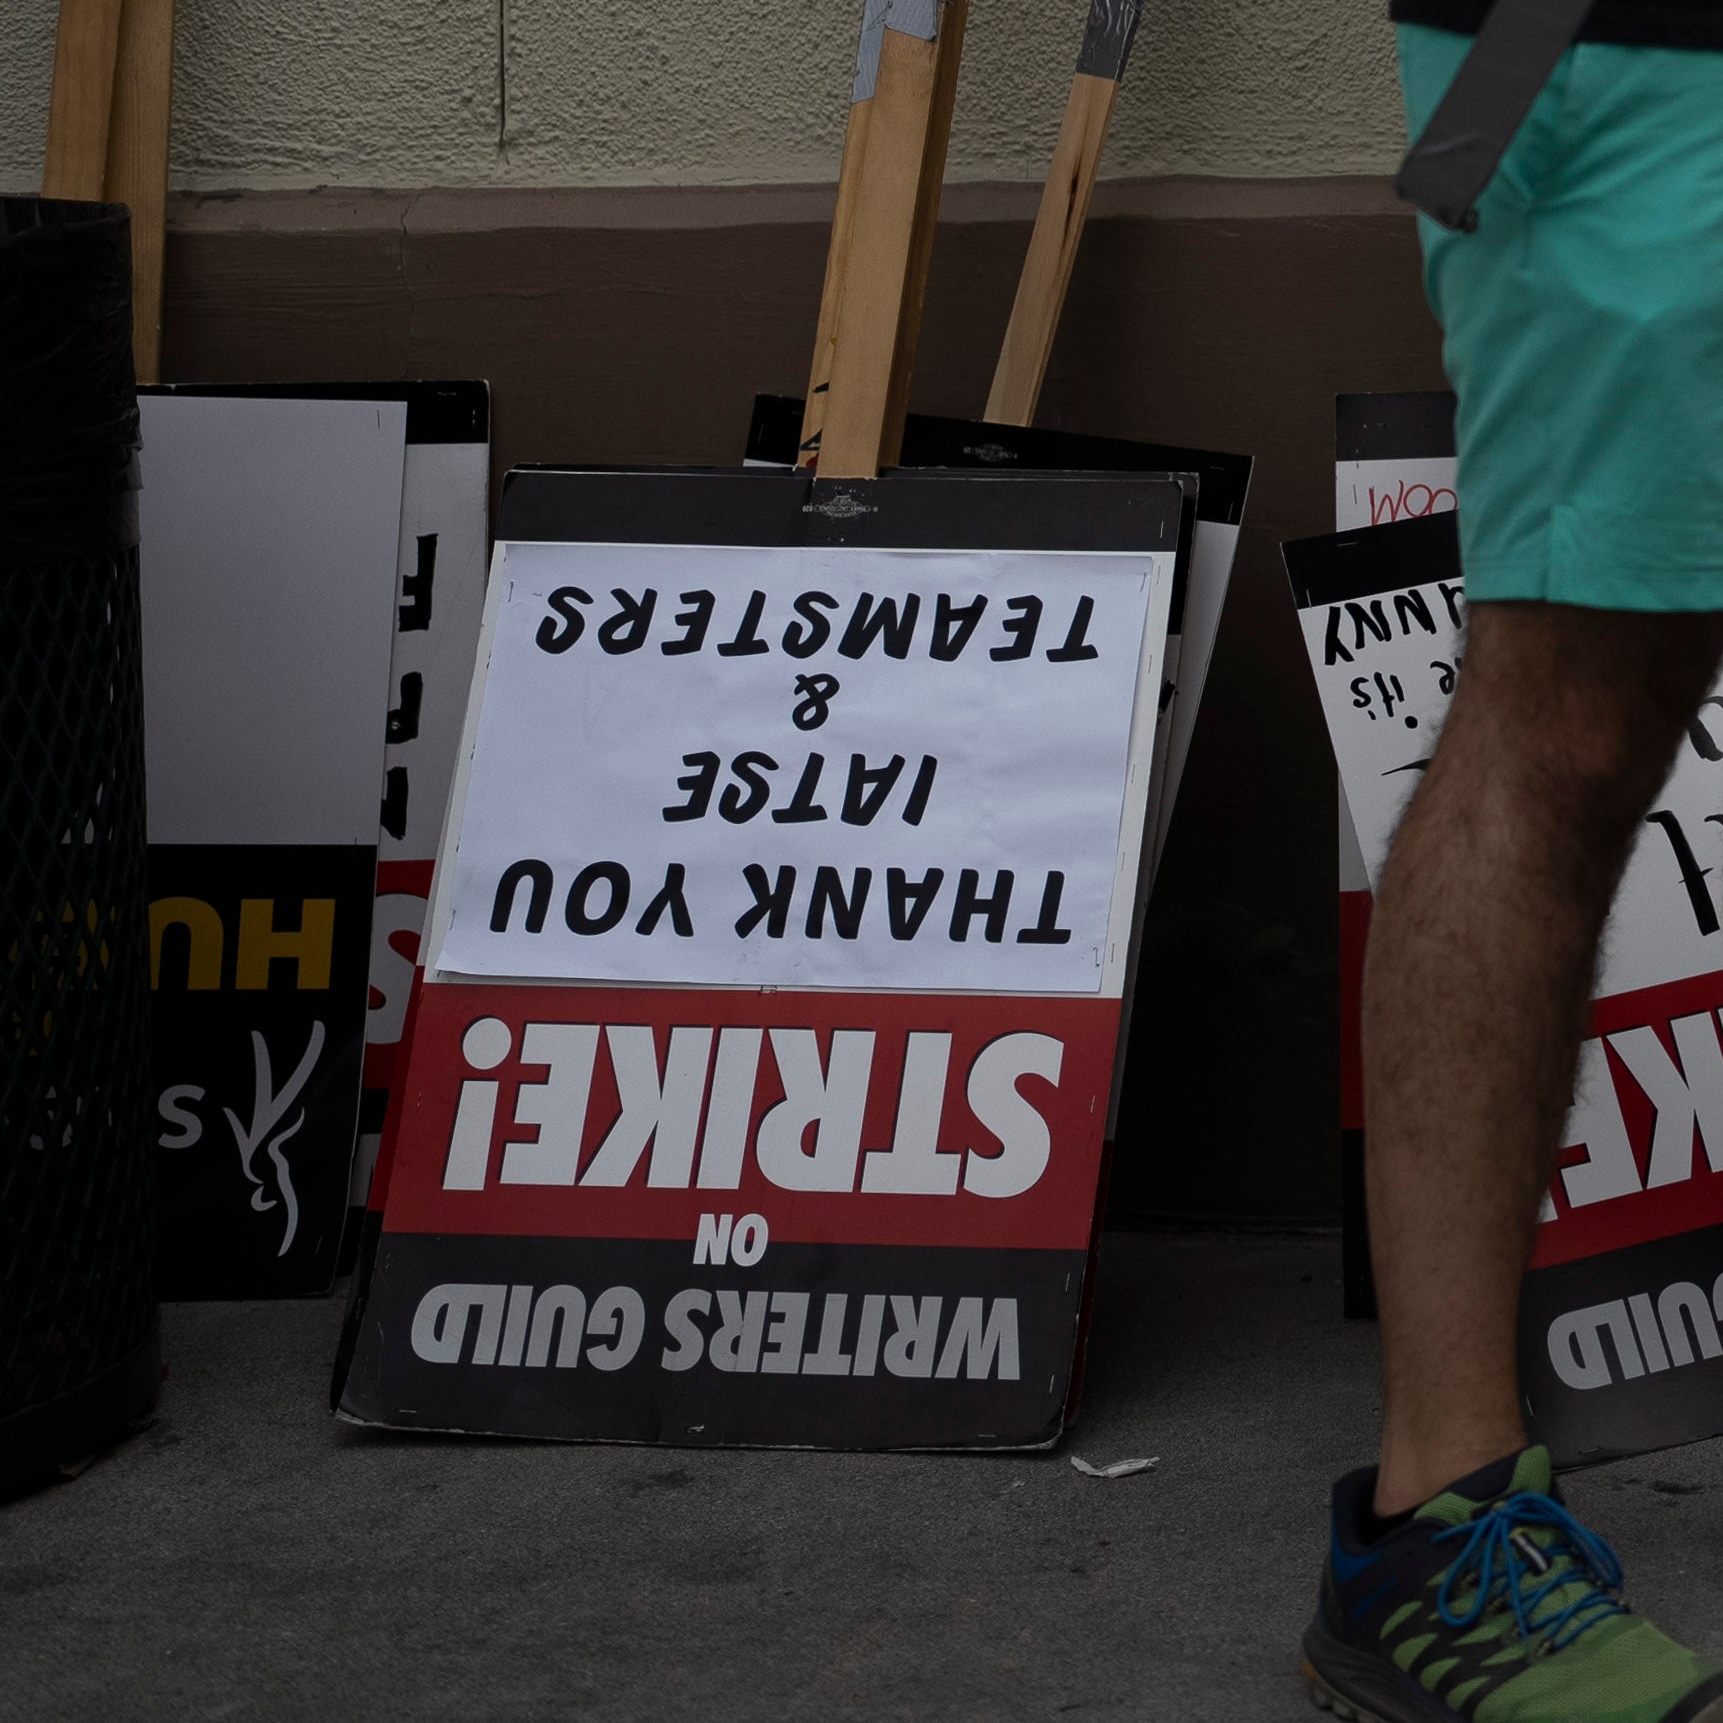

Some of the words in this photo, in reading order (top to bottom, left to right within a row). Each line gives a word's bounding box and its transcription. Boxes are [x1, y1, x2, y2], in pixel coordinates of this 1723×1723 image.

[535, 586, 1100, 664] TEAMSTERS
[793, 674, 840, 731] &
[662, 751, 938, 828] IATSE
[490, 858, 696, 937] YOU
[736, 864, 1072, 945] THANK
[443, 1016, 1065, 1198] STRIKE!
[693, 1213, 770, 1268] ON
[410, 1283, 645, 1371] GUILD
[661, 1289, 1022, 1381] WRITERS
